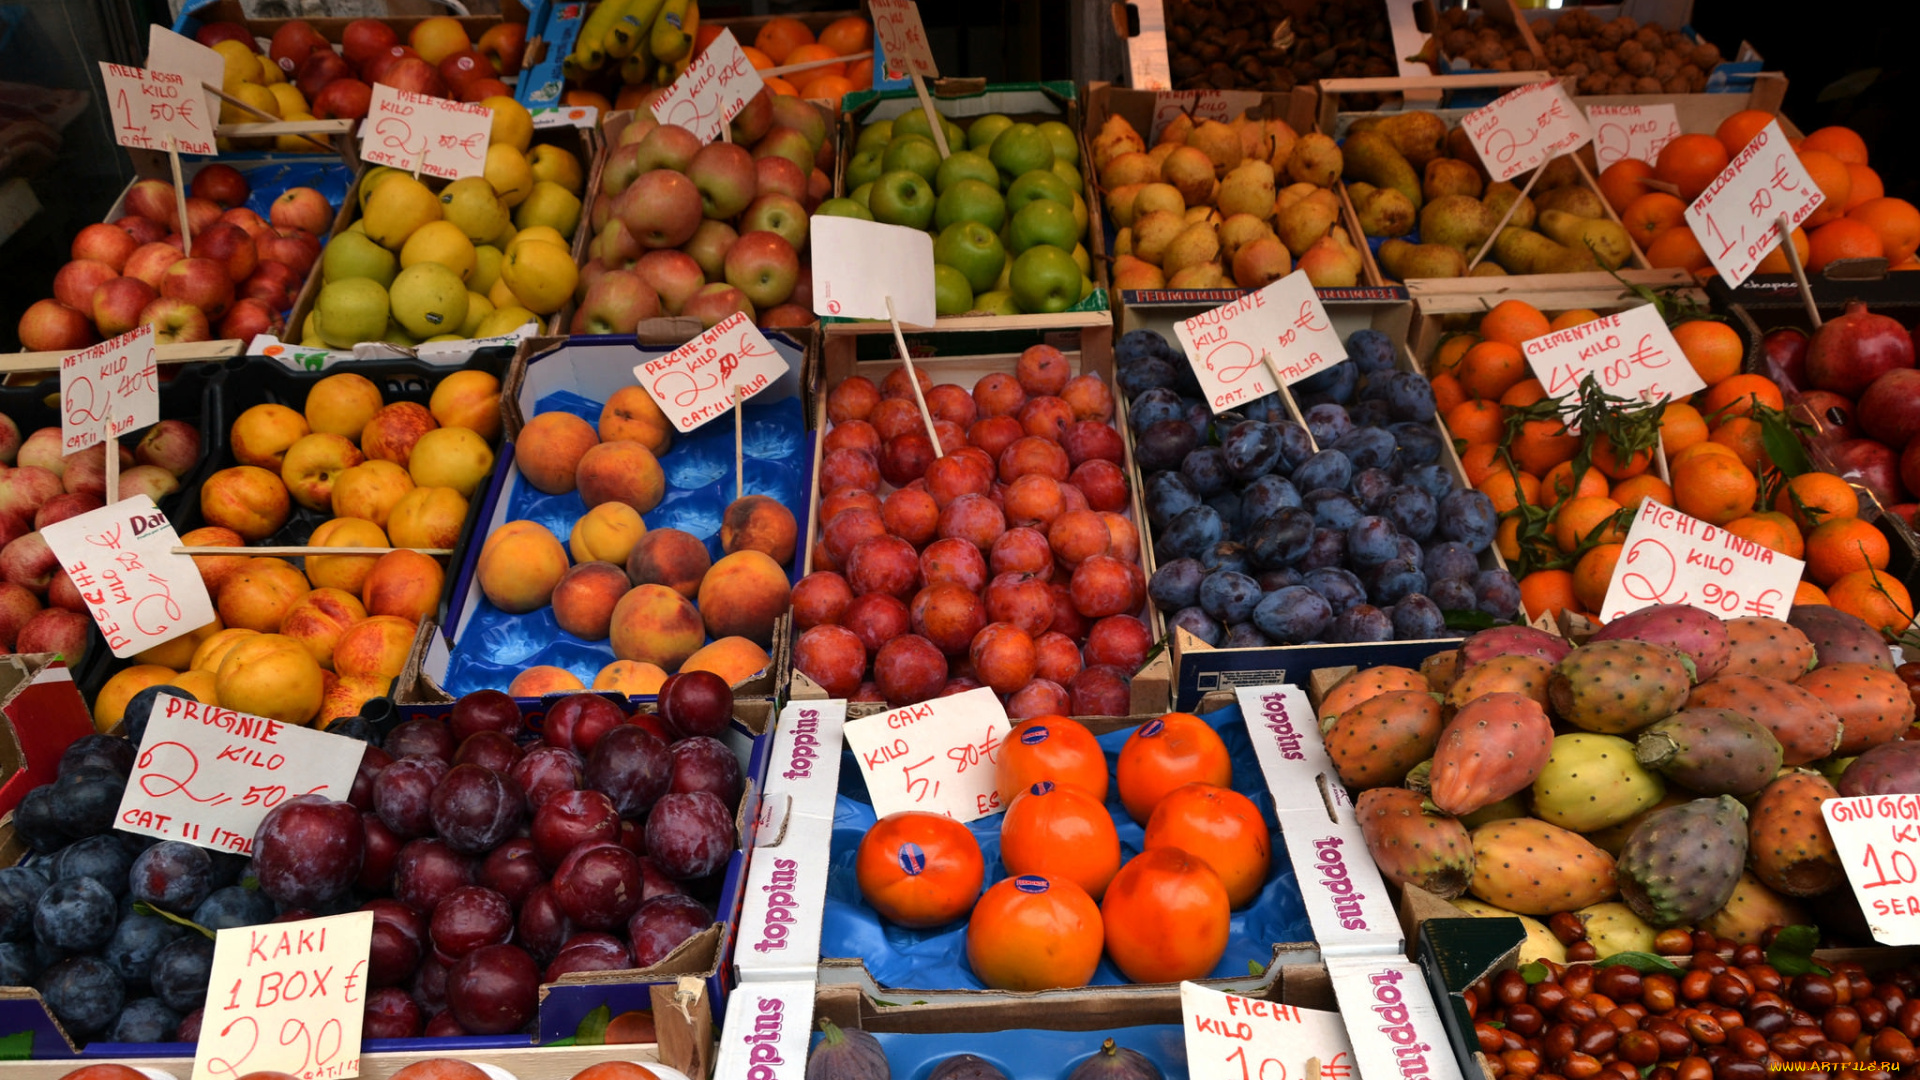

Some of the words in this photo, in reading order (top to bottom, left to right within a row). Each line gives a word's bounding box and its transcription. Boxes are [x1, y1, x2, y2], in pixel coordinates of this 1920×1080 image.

[109, 63, 144, 80] MELE
[150, 70, 184, 86] ROSSA
[689, 63, 716, 99] KILO
[141, 83, 178, 98] KILO
[651, 82, 680, 112] MELE
[379, 99, 415, 116] KILO
[1474, 115, 1499, 141] KILO
[1629, 120, 1657, 136] KILO
[1693, 130, 1769, 217] MELOGRANO
[1185, 288, 1267, 336] PRUGNE
[1192, 325, 1228, 351] KILO
[1526, 313, 1622, 356] CLEMENTINE
[1578, 334, 1621, 361] KILO
[99, 355, 128, 381] KILO
[685, 347, 718, 374] KILO
[1641, 500, 1699, 536] FICHI
[1701, 525, 1775, 566] D'INDIA
[1686, 547, 1735, 576] KILO
[102, 569, 133, 605] KILO
[165, 697, 285, 745] PRUGNIE
[887, 702, 935, 730] CAKI
[1260, 692, 1305, 761] toppins
[215, 744, 285, 770] KILO
[782, 709, 821, 781] toppins
[862, 738, 910, 772] KILO
[122, 808, 172, 834] CAT.
[1312, 835, 1368, 931] toppins
[754, 858, 800, 954] toppins
[246, 927, 327, 968] KAKI
[223, 977, 242, 1011] 1
[255, 965, 334, 1009] BOX
[1225, 995, 1303, 1024] FICHI
[1367, 967, 1432, 1080] toppin
[1195, 1014, 1253, 1041] KILO
